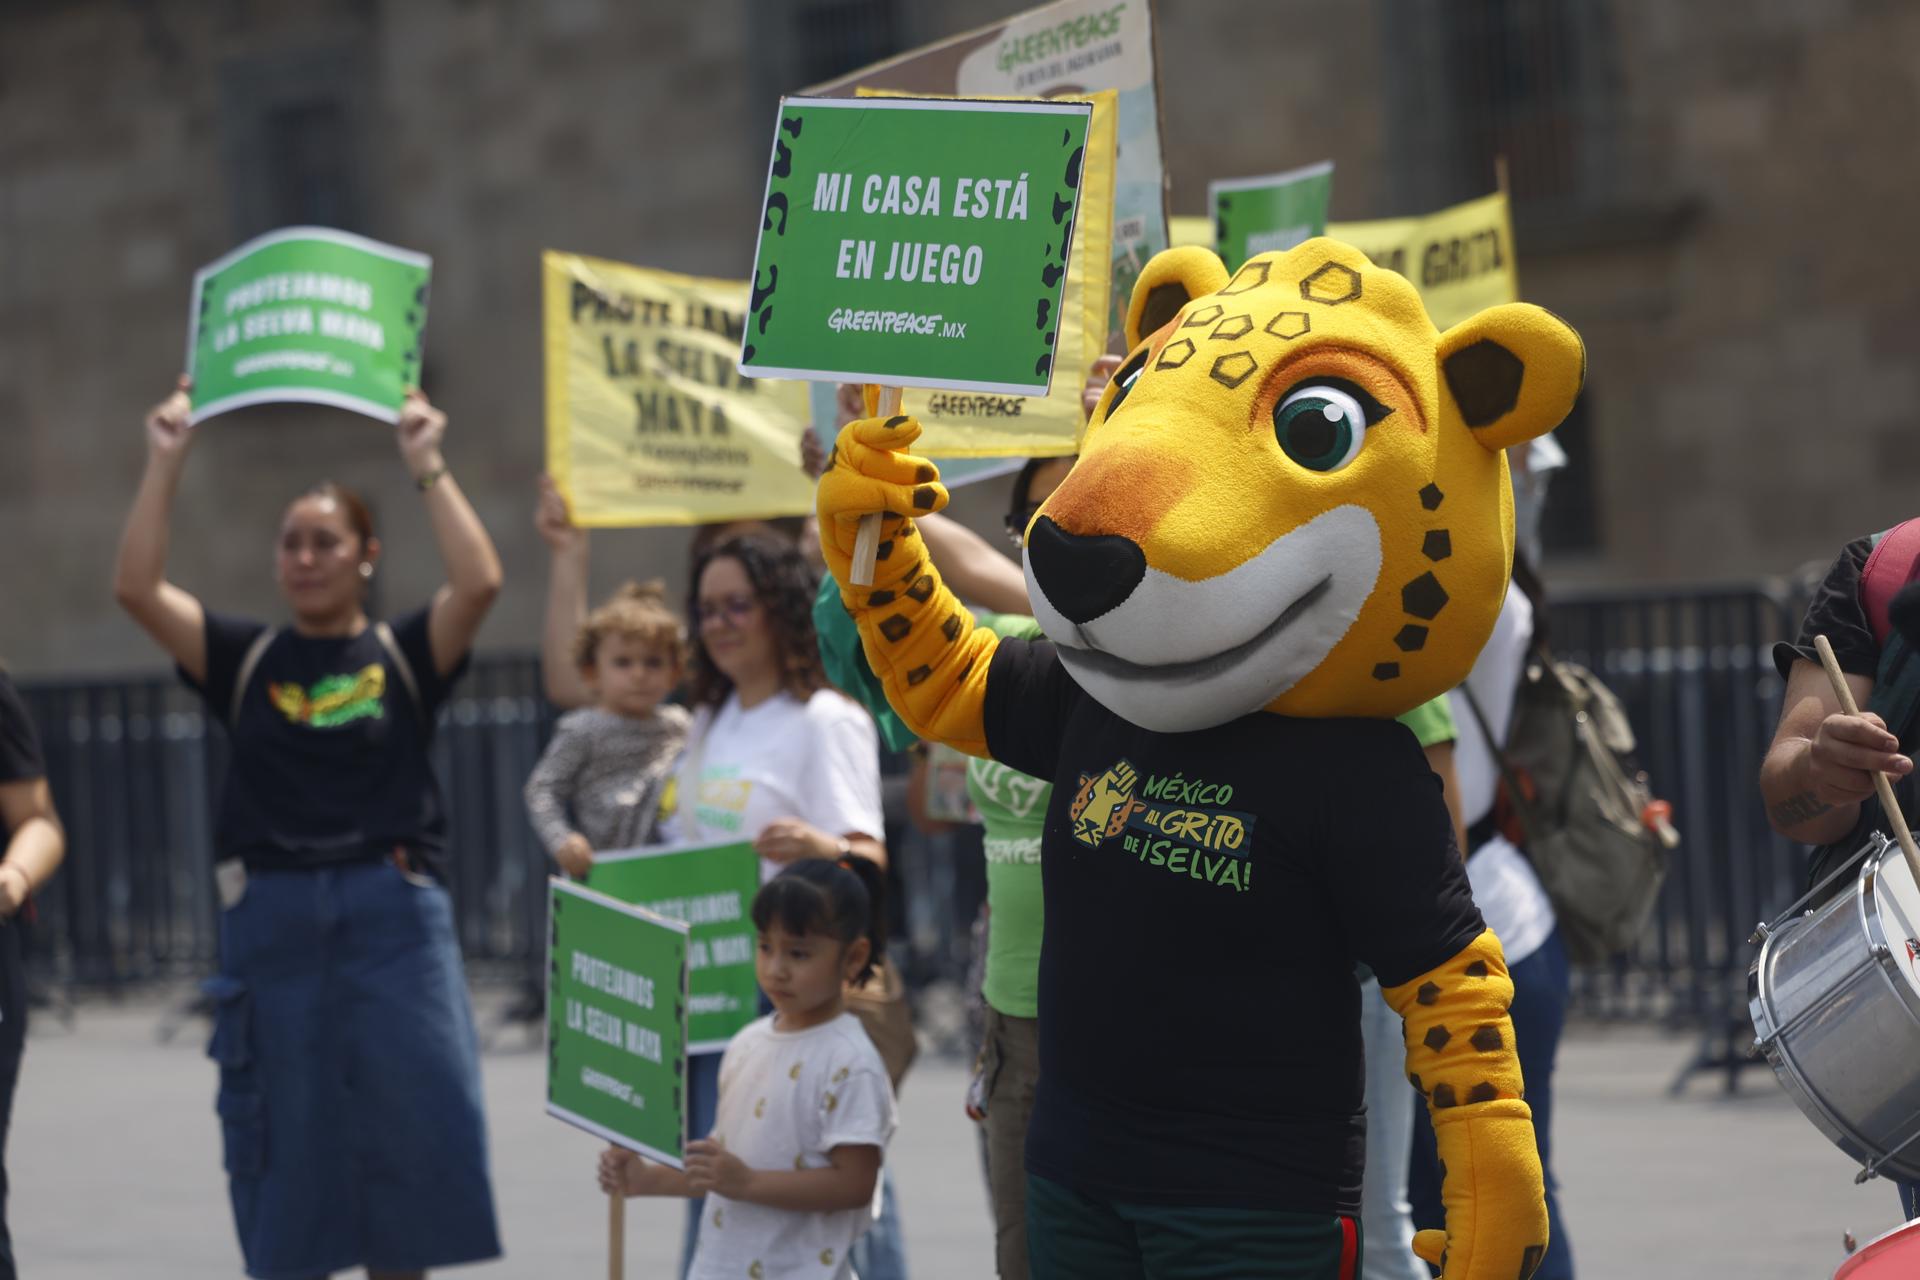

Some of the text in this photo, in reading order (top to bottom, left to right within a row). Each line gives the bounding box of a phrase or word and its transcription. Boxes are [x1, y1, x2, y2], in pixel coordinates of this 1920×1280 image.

[812, 172, 1030, 220] MI CASA ESTÁ
[835, 239, 984, 285] EN JUEGO
[827, 308, 966, 339] GREENPEACE.MX
[928, 394, 1027, 418] GREENPEACE
[1144, 809, 1160, 826] AL
[1124, 834, 1140, 853] DE
[566, 997, 583, 1032] LA
